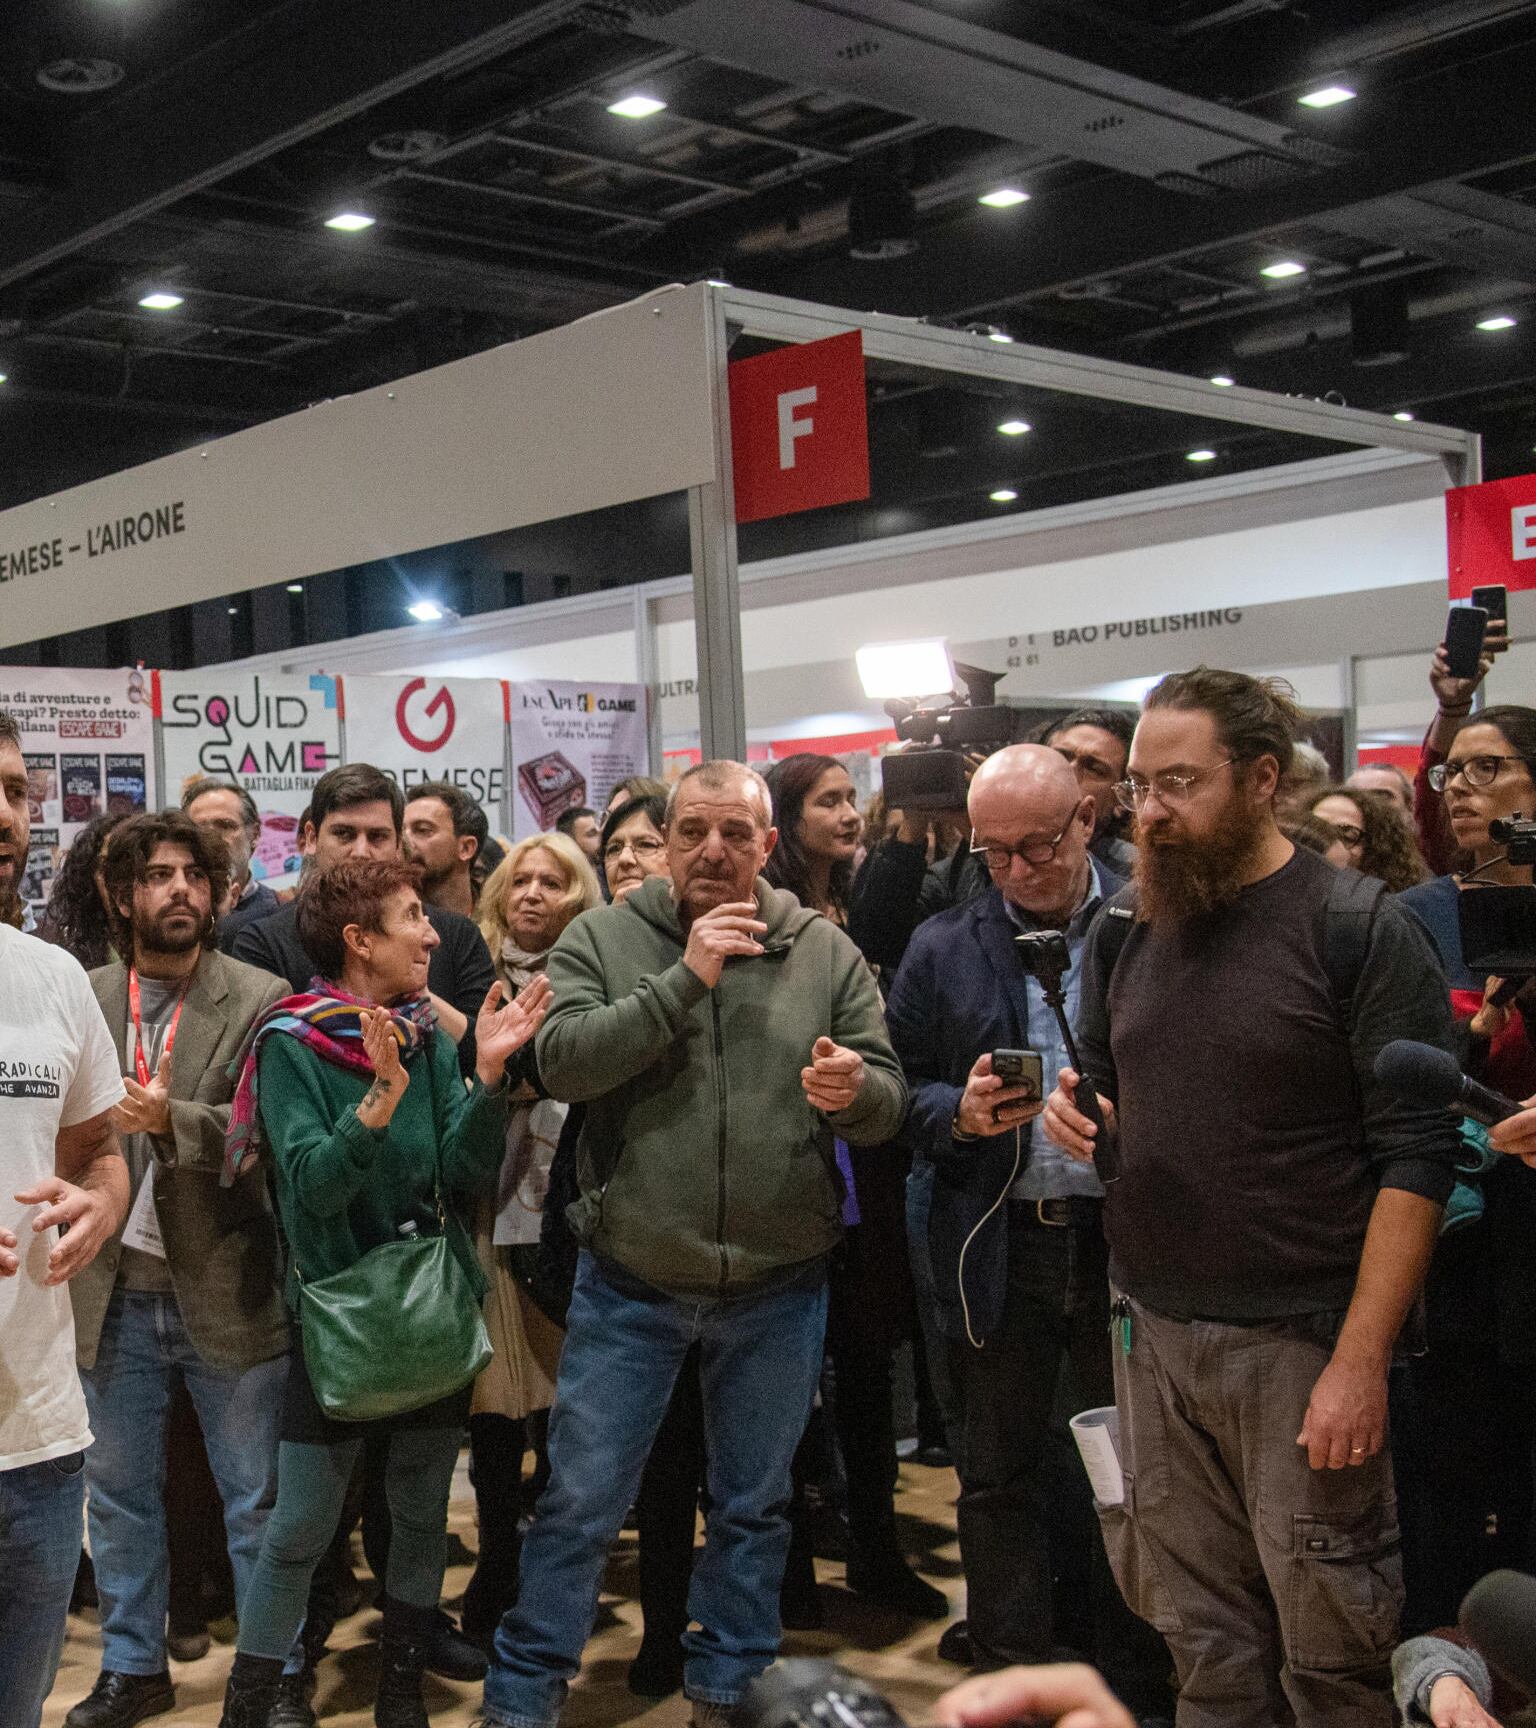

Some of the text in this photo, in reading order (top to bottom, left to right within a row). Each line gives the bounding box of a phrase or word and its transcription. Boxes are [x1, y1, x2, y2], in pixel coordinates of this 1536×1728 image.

[777, 386, 817, 470] F
[87, 501, 186, 558] L'AIRONE
[1510, 503, 1536, 561] E
[1052, 606, 1243, 648] BAO PUBLISHING
[13, 692, 27, 703] di
[29, 694, 100, 704] avventure
[103, 696, 112, 704] e
[49, 707, 97, 719] Presto
[99, 708, 141, 719] detto:
[162, 675, 308, 729] SQUID
[597, 699, 637, 713] GAME
[199, 740, 340, 785] GAME
[244, 776, 320, 791] BATTAGLIA FINA
[0, 1061, 61, 1080] RADICALI
[24, 1086, 57, 1096] AVANZA
